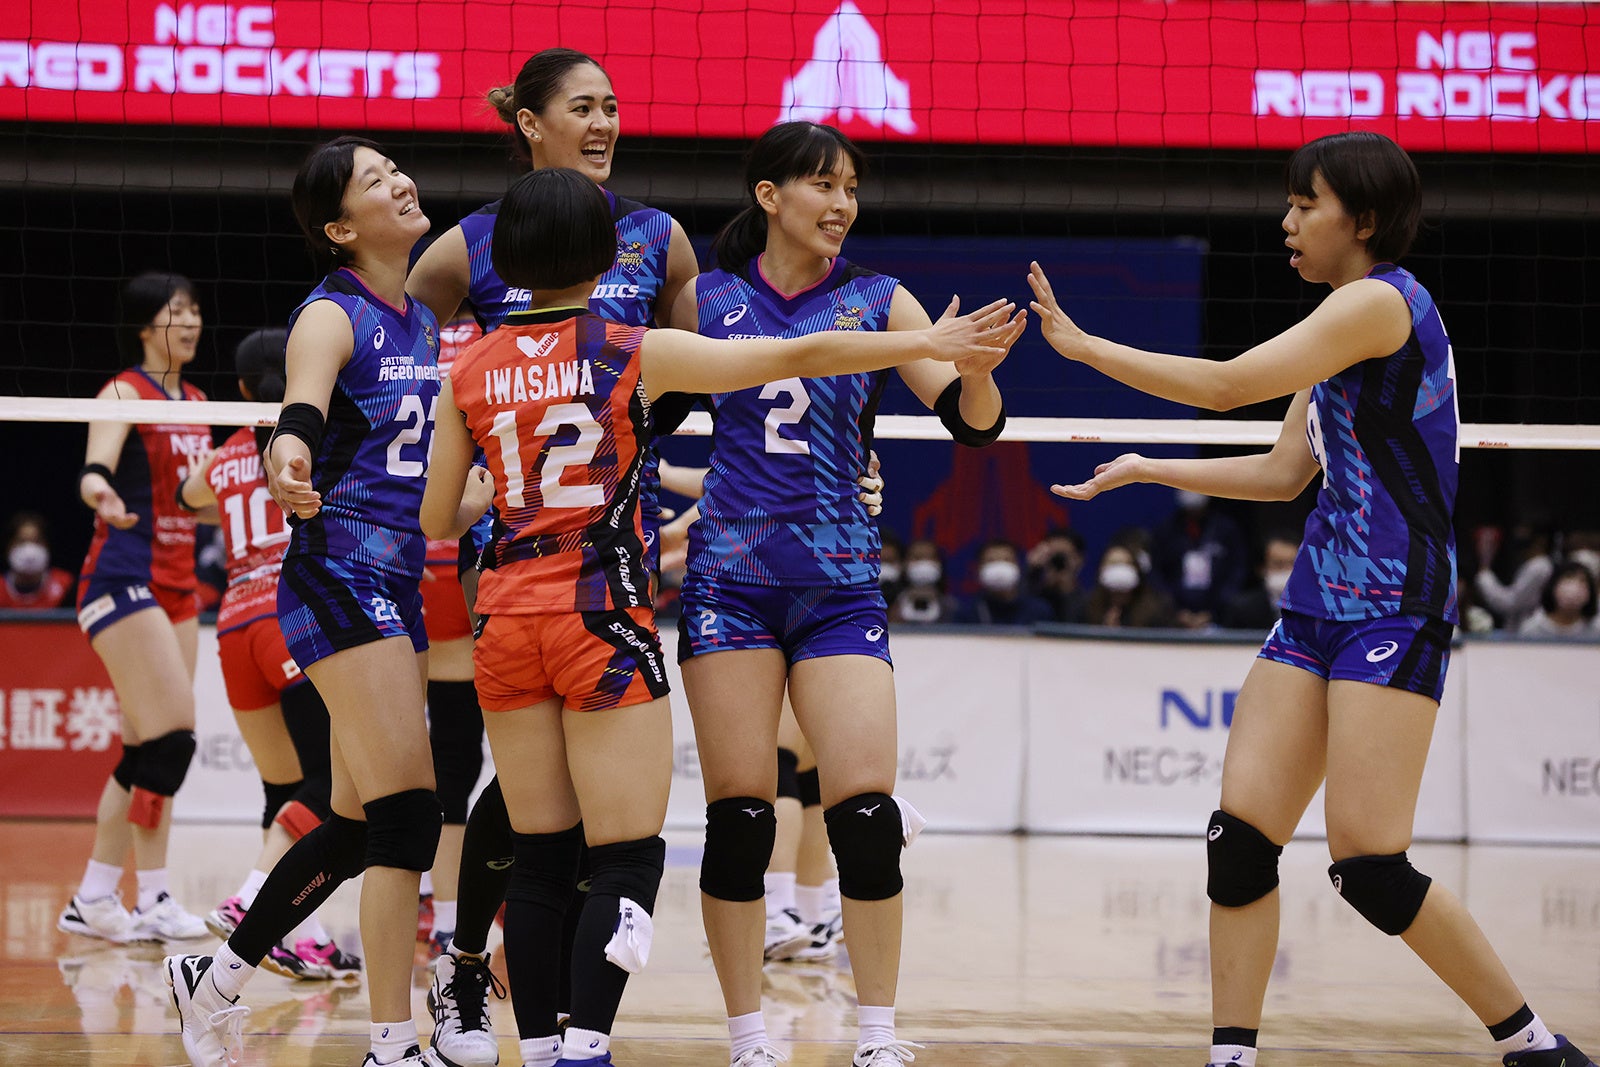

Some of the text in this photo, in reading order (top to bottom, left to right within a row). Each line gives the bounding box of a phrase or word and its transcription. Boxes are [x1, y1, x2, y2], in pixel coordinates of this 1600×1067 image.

[134, 46, 441, 98] ROCKETS
[1253, 69, 1384, 118] RED
[485, 358, 596, 406] IWASAWA
[757, 376, 812, 455] 2
[487, 402, 606, 509] 12
[700, 609, 718, 636] 2
[0, 687, 122, 751] 証券
